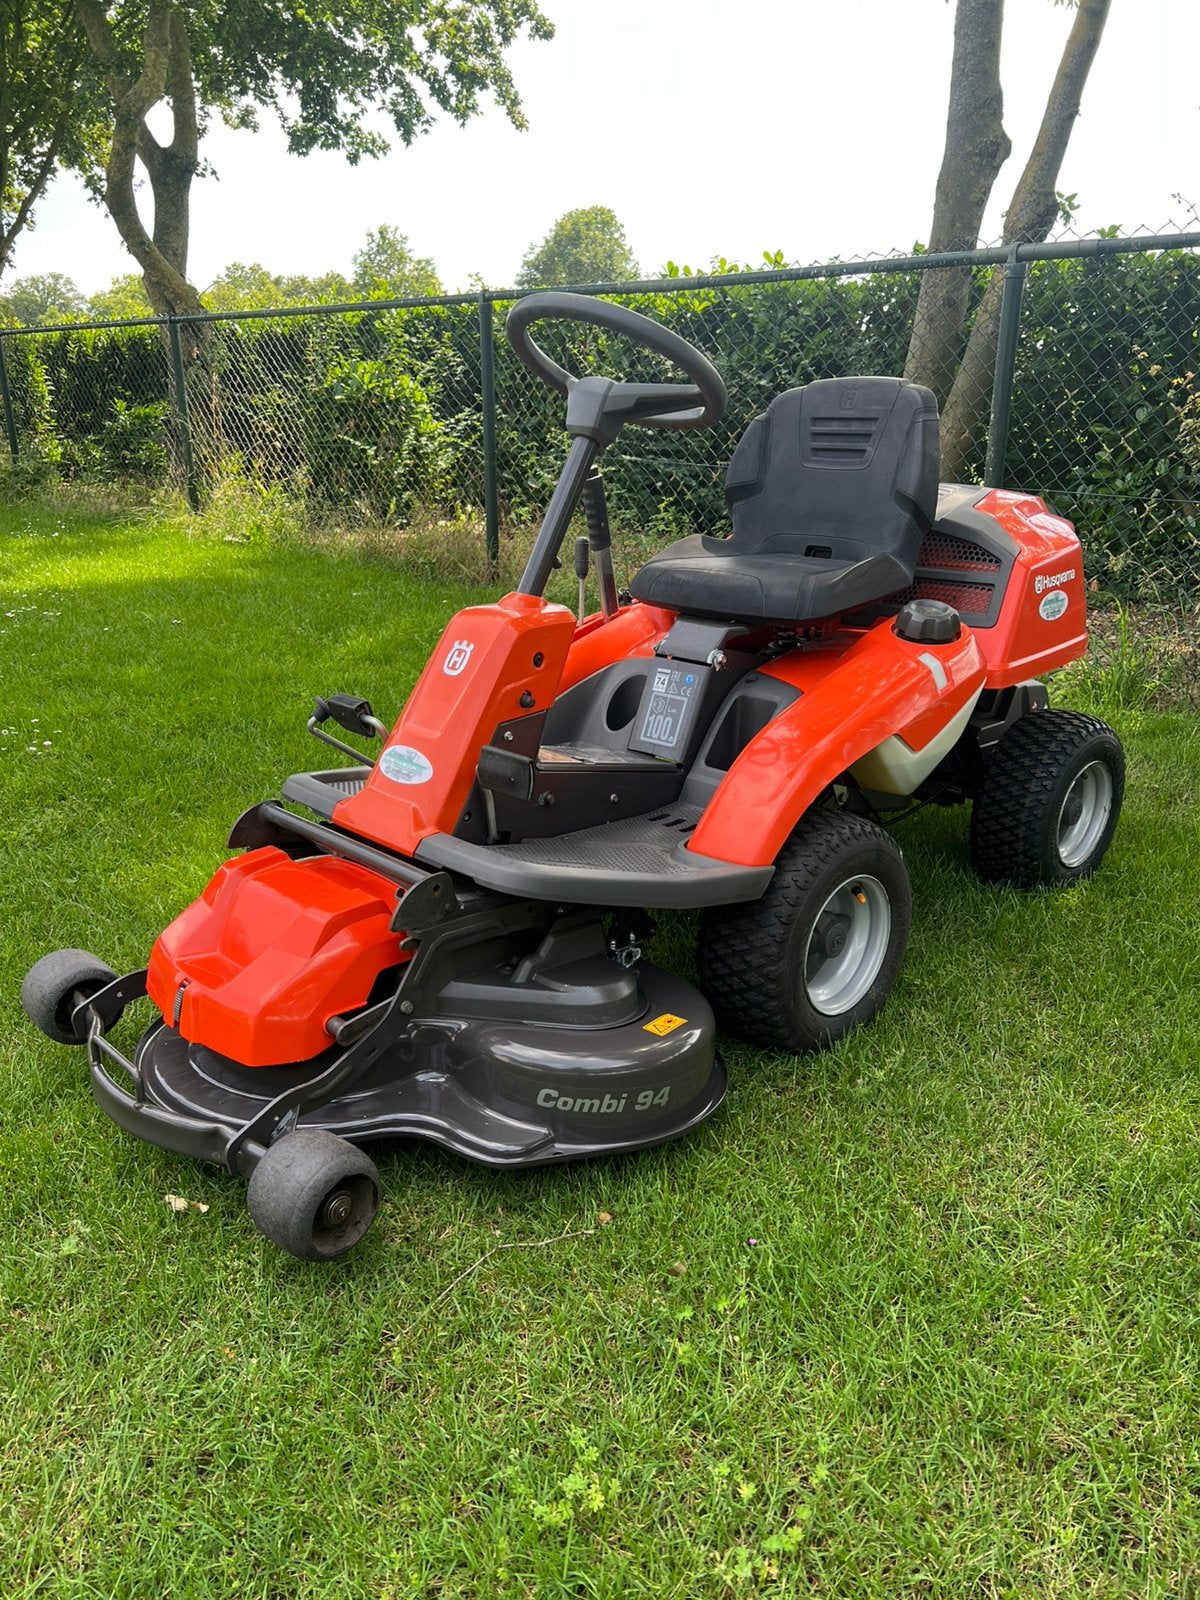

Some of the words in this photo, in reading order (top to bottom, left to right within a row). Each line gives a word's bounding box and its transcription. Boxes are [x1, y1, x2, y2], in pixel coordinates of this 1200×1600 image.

[1043, 569, 1075, 588] Husqvarna
[656, 676, 666, 686] 74
[646, 713, 673, 741] 100
[536, 1088, 628, 1113] Combi
[634, 1086, 671, 1111] 94
